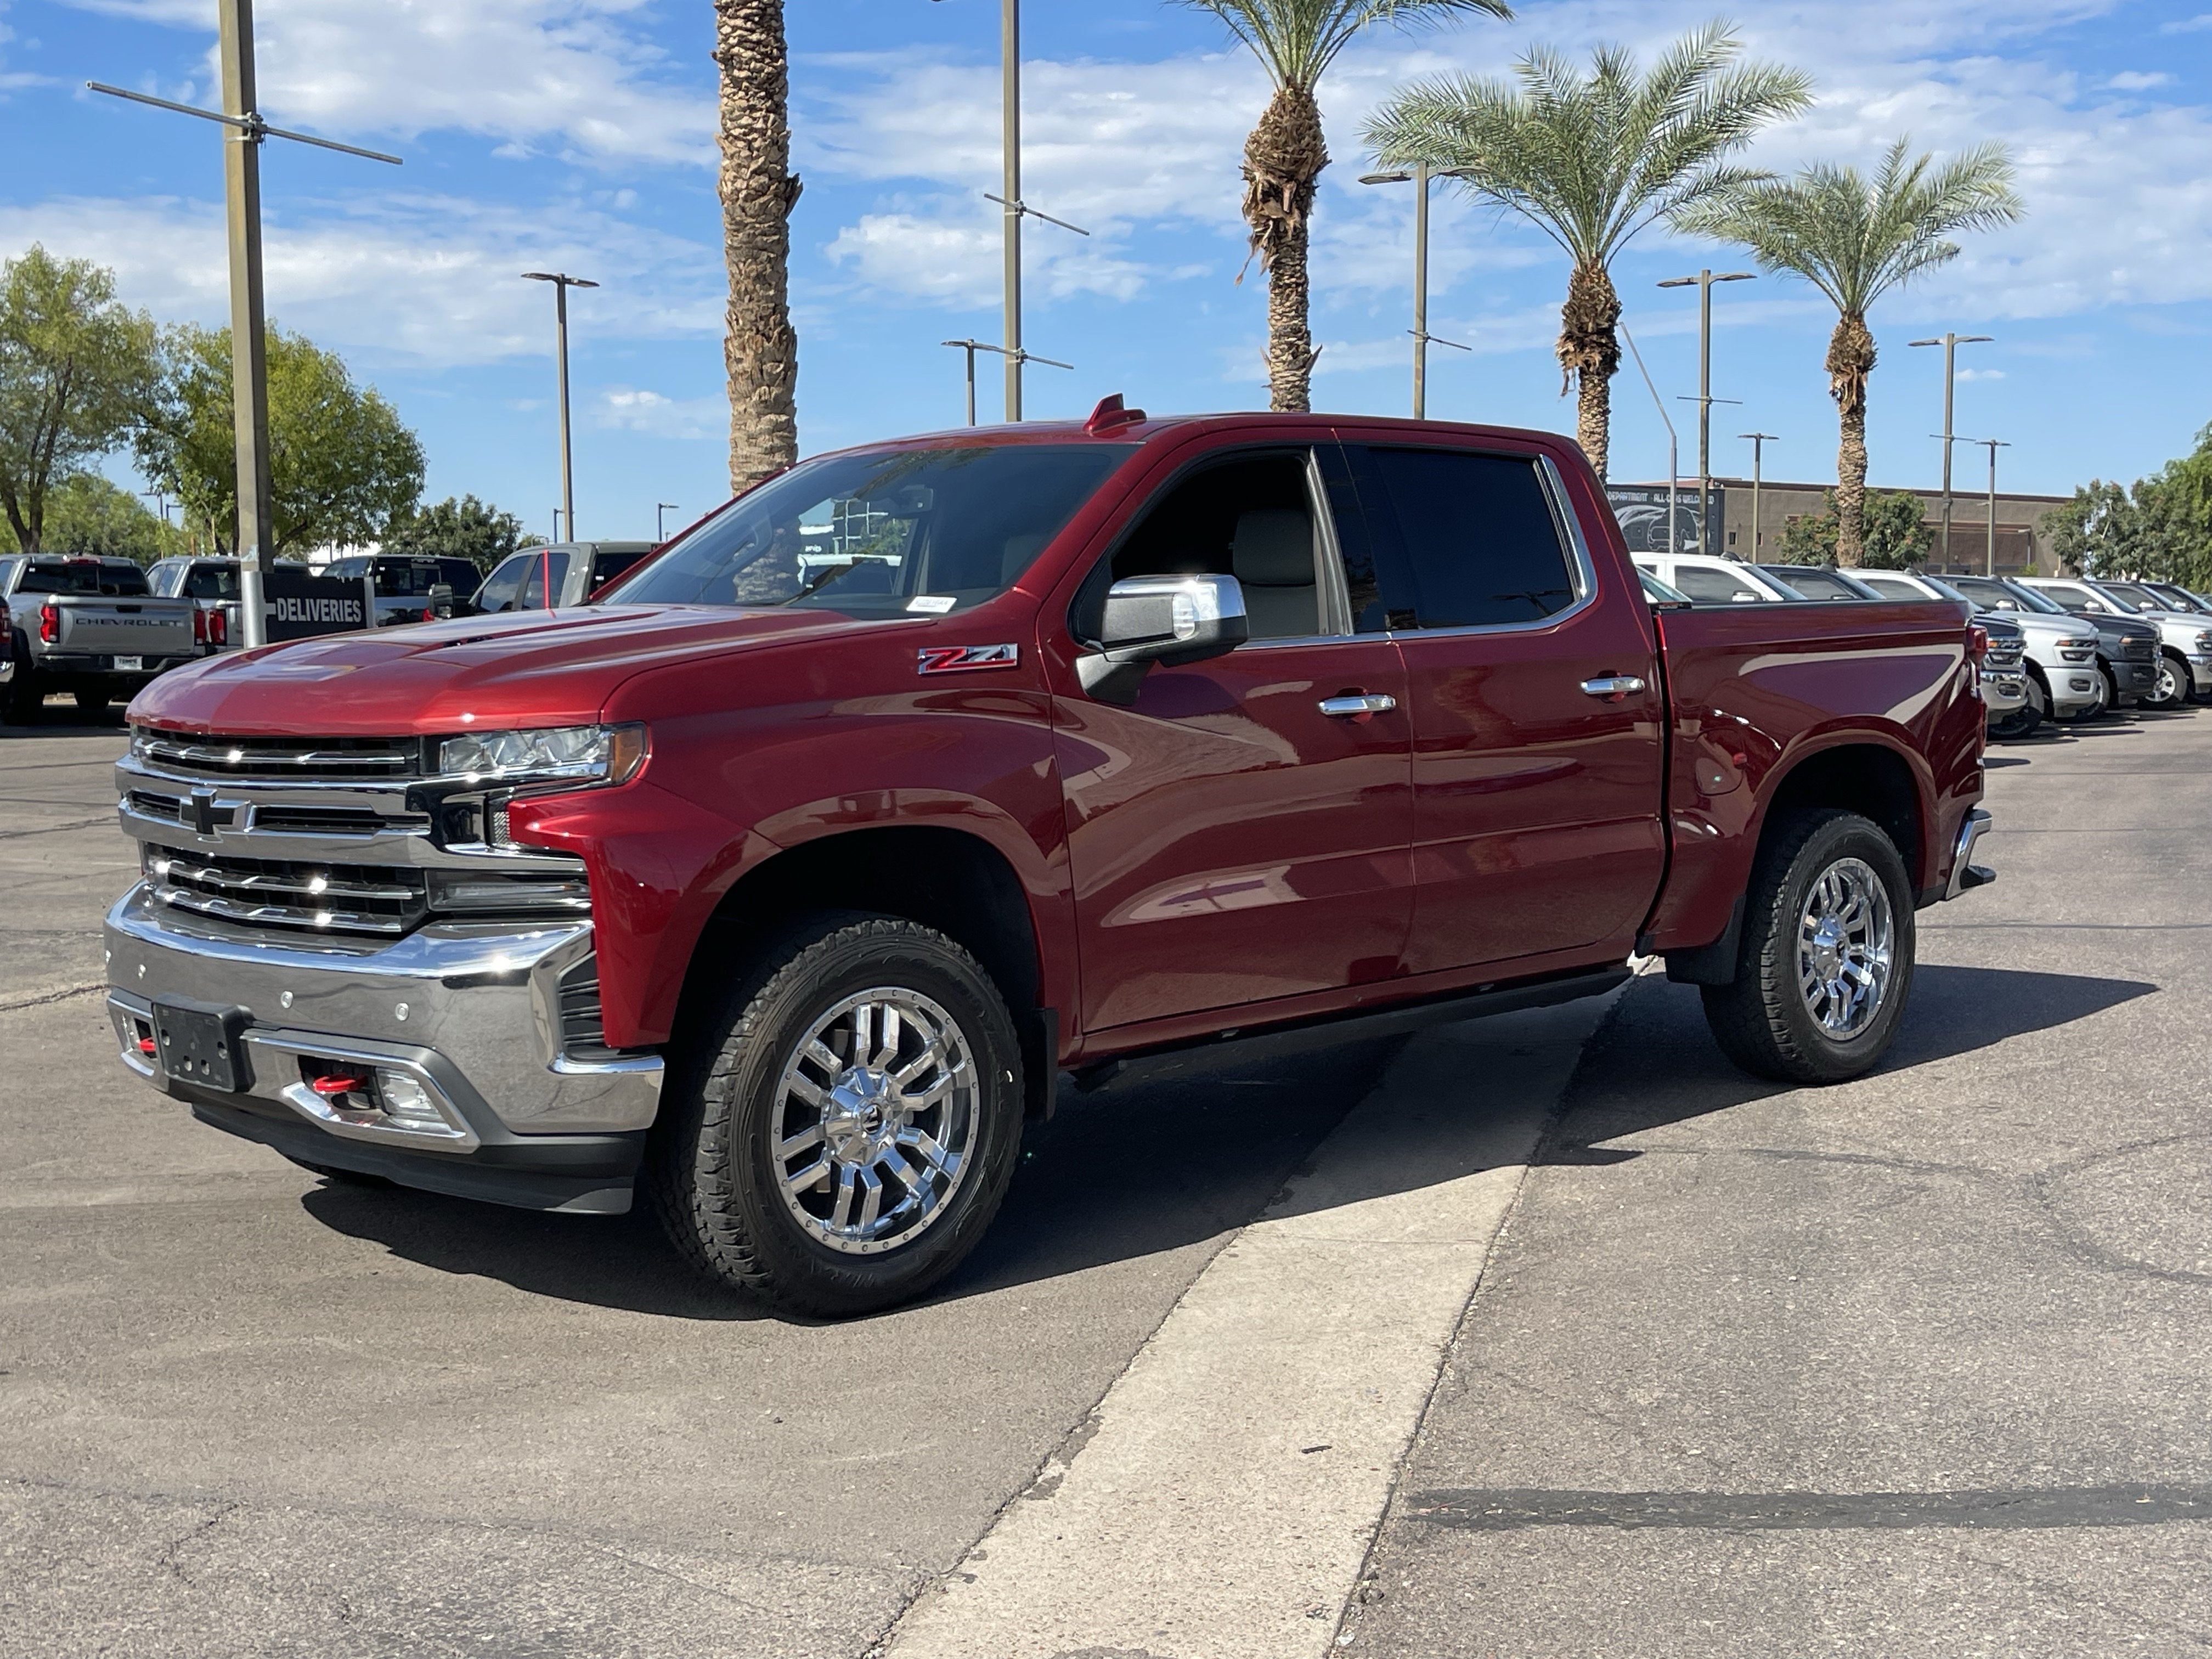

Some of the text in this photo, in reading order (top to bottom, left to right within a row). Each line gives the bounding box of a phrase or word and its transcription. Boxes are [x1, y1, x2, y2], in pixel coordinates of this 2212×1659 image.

[1654, 493, 1665, 503] ALL
[1666, 494, 1681, 503] CS
[1682, 495, 1714, 505] WELCED
[276, 597, 362, 622] DELIVERIES
[76, 618, 181, 627] CHEVROLET
[918, 643, 1018, 674] Z71
